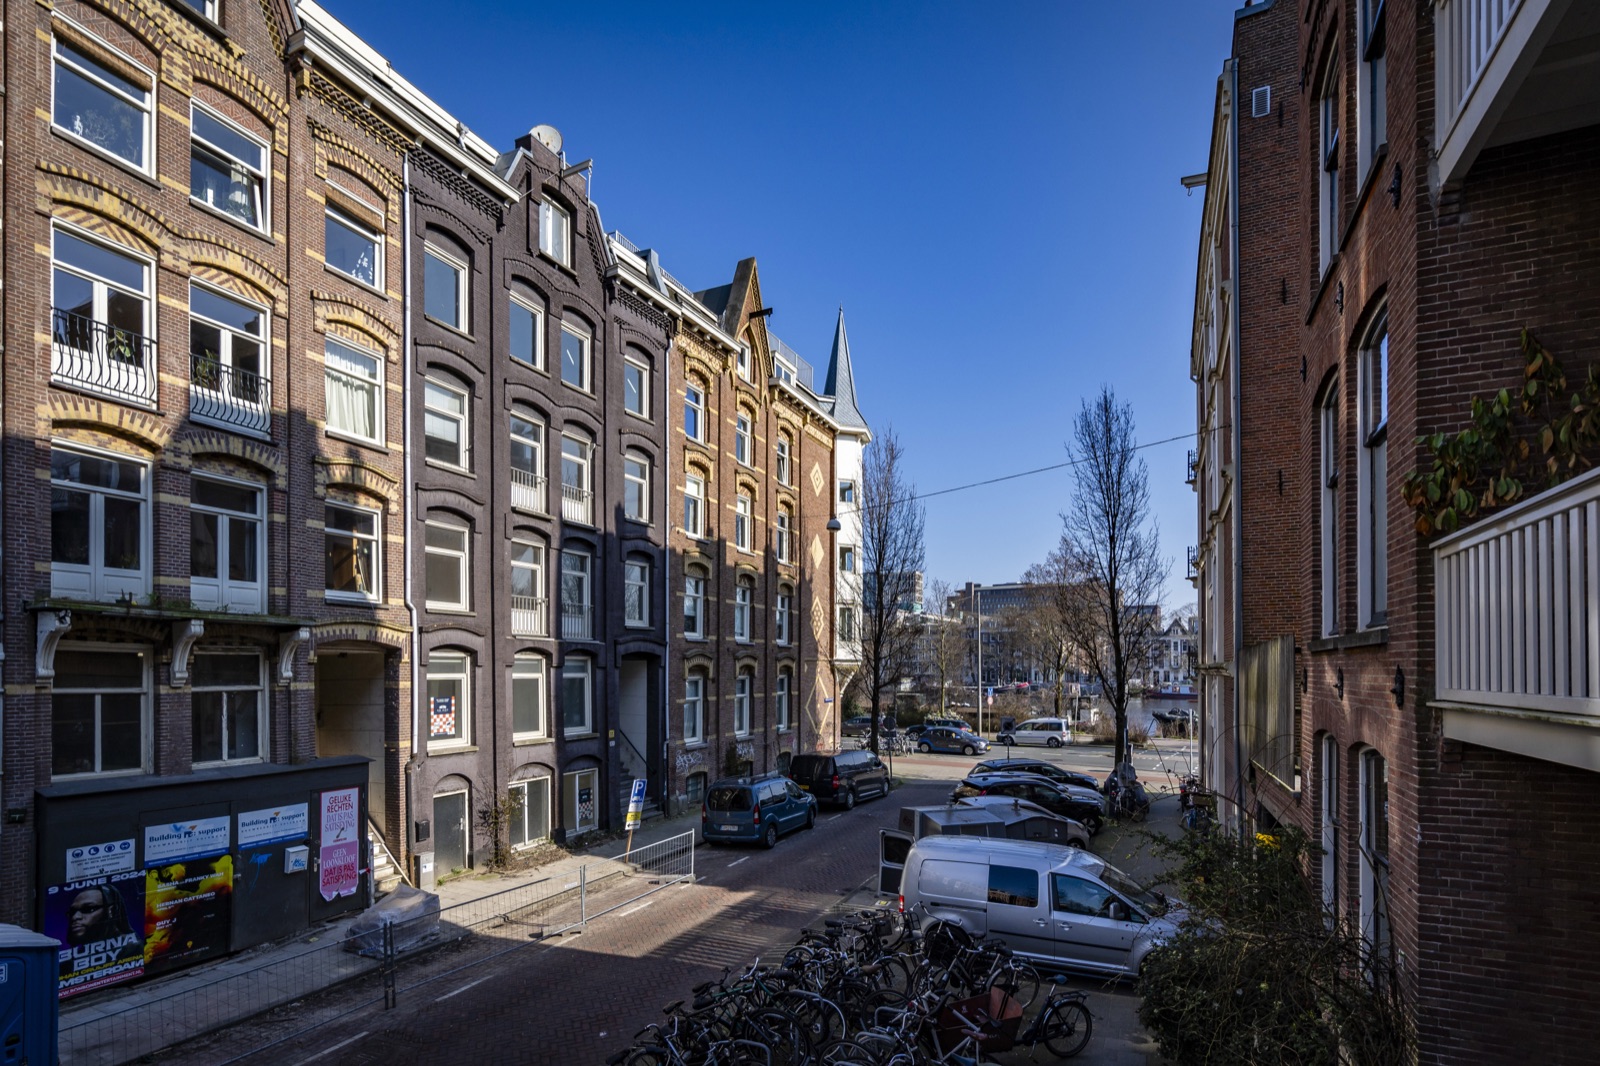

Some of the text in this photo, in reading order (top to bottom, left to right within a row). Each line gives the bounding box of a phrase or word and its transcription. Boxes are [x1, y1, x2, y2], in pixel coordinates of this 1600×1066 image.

[635, 781, 644, 794] P
[326, 802, 353, 813] RECHTEN
[241, 819, 268, 828] Building
[281, 812, 305, 821] support
[326, 811, 354, 823] DAT IS PAS
[149, 832, 182, 843] Building
[198, 826, 226, 835] support
[332, 848, 347, 858] GEEN
[324, 862, 355, 878] DAT IS PAS
[48, 886, 59, 895] 9
[63, 877, 107, 891] JUNE
[111, 869, 146, 883] 2024
[322, 870, 357, 887] SATISFYING
[59, 932, 139, 963] BURNA
[73, 947, 122, 972] BOY
[117, 954, 144, 964] ARENA
[59, 958, 144, 989] MSTERDAM
